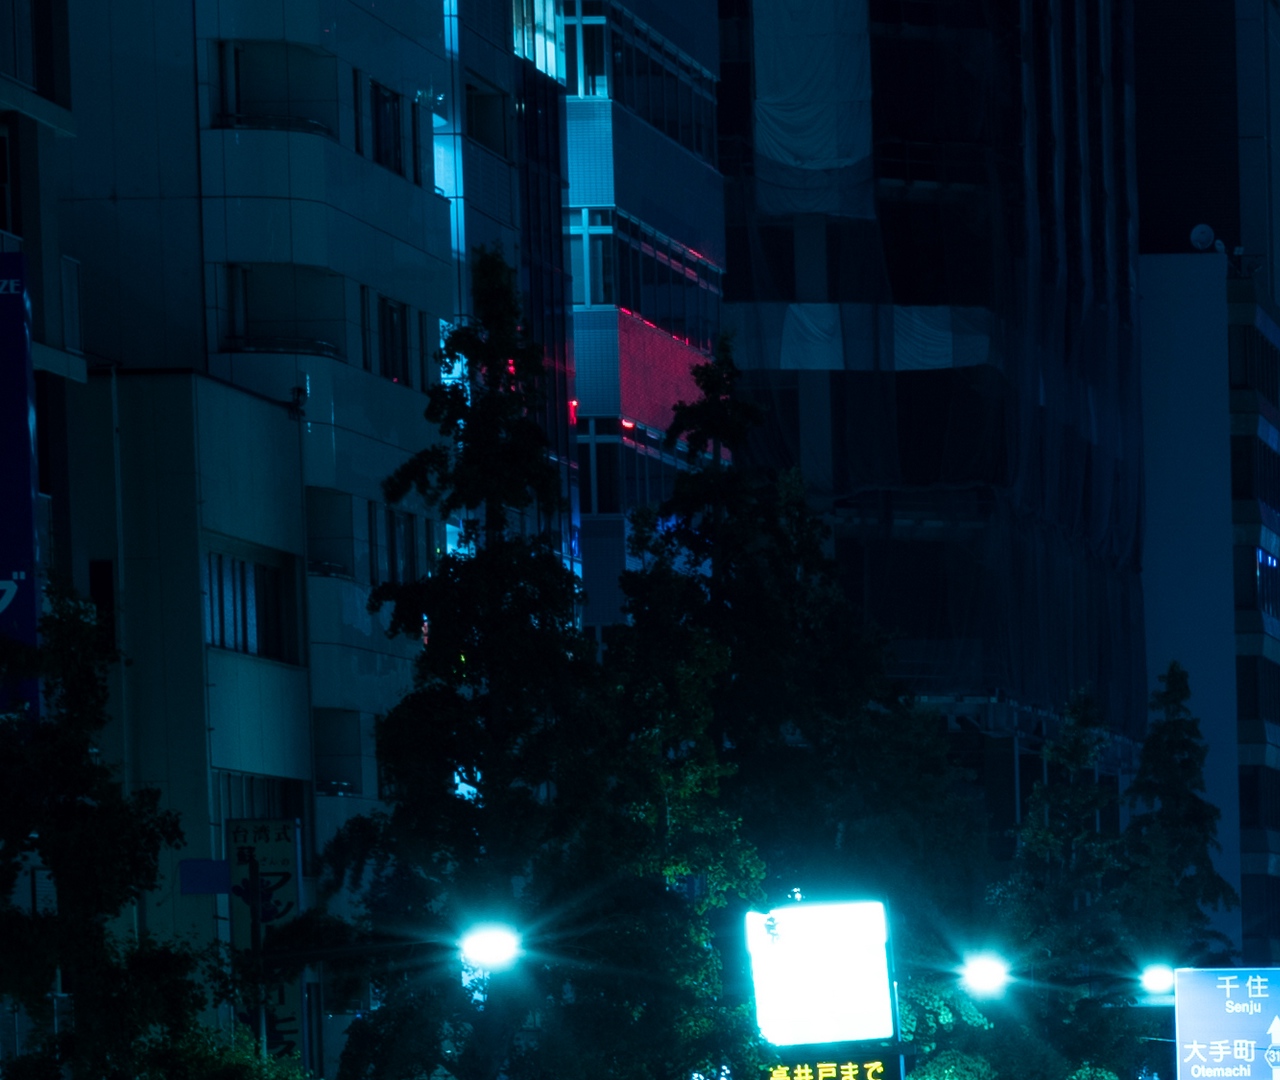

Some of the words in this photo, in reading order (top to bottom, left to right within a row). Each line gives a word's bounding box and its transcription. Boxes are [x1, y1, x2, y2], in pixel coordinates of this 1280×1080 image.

[1216, 974, 1270, 999] 千住
[1225, 1000, 1262, 1015] Senju
[1183, 1039, 1256, 1063] 大手町
[1191, 1064, 1251, 1078] Otemachi
